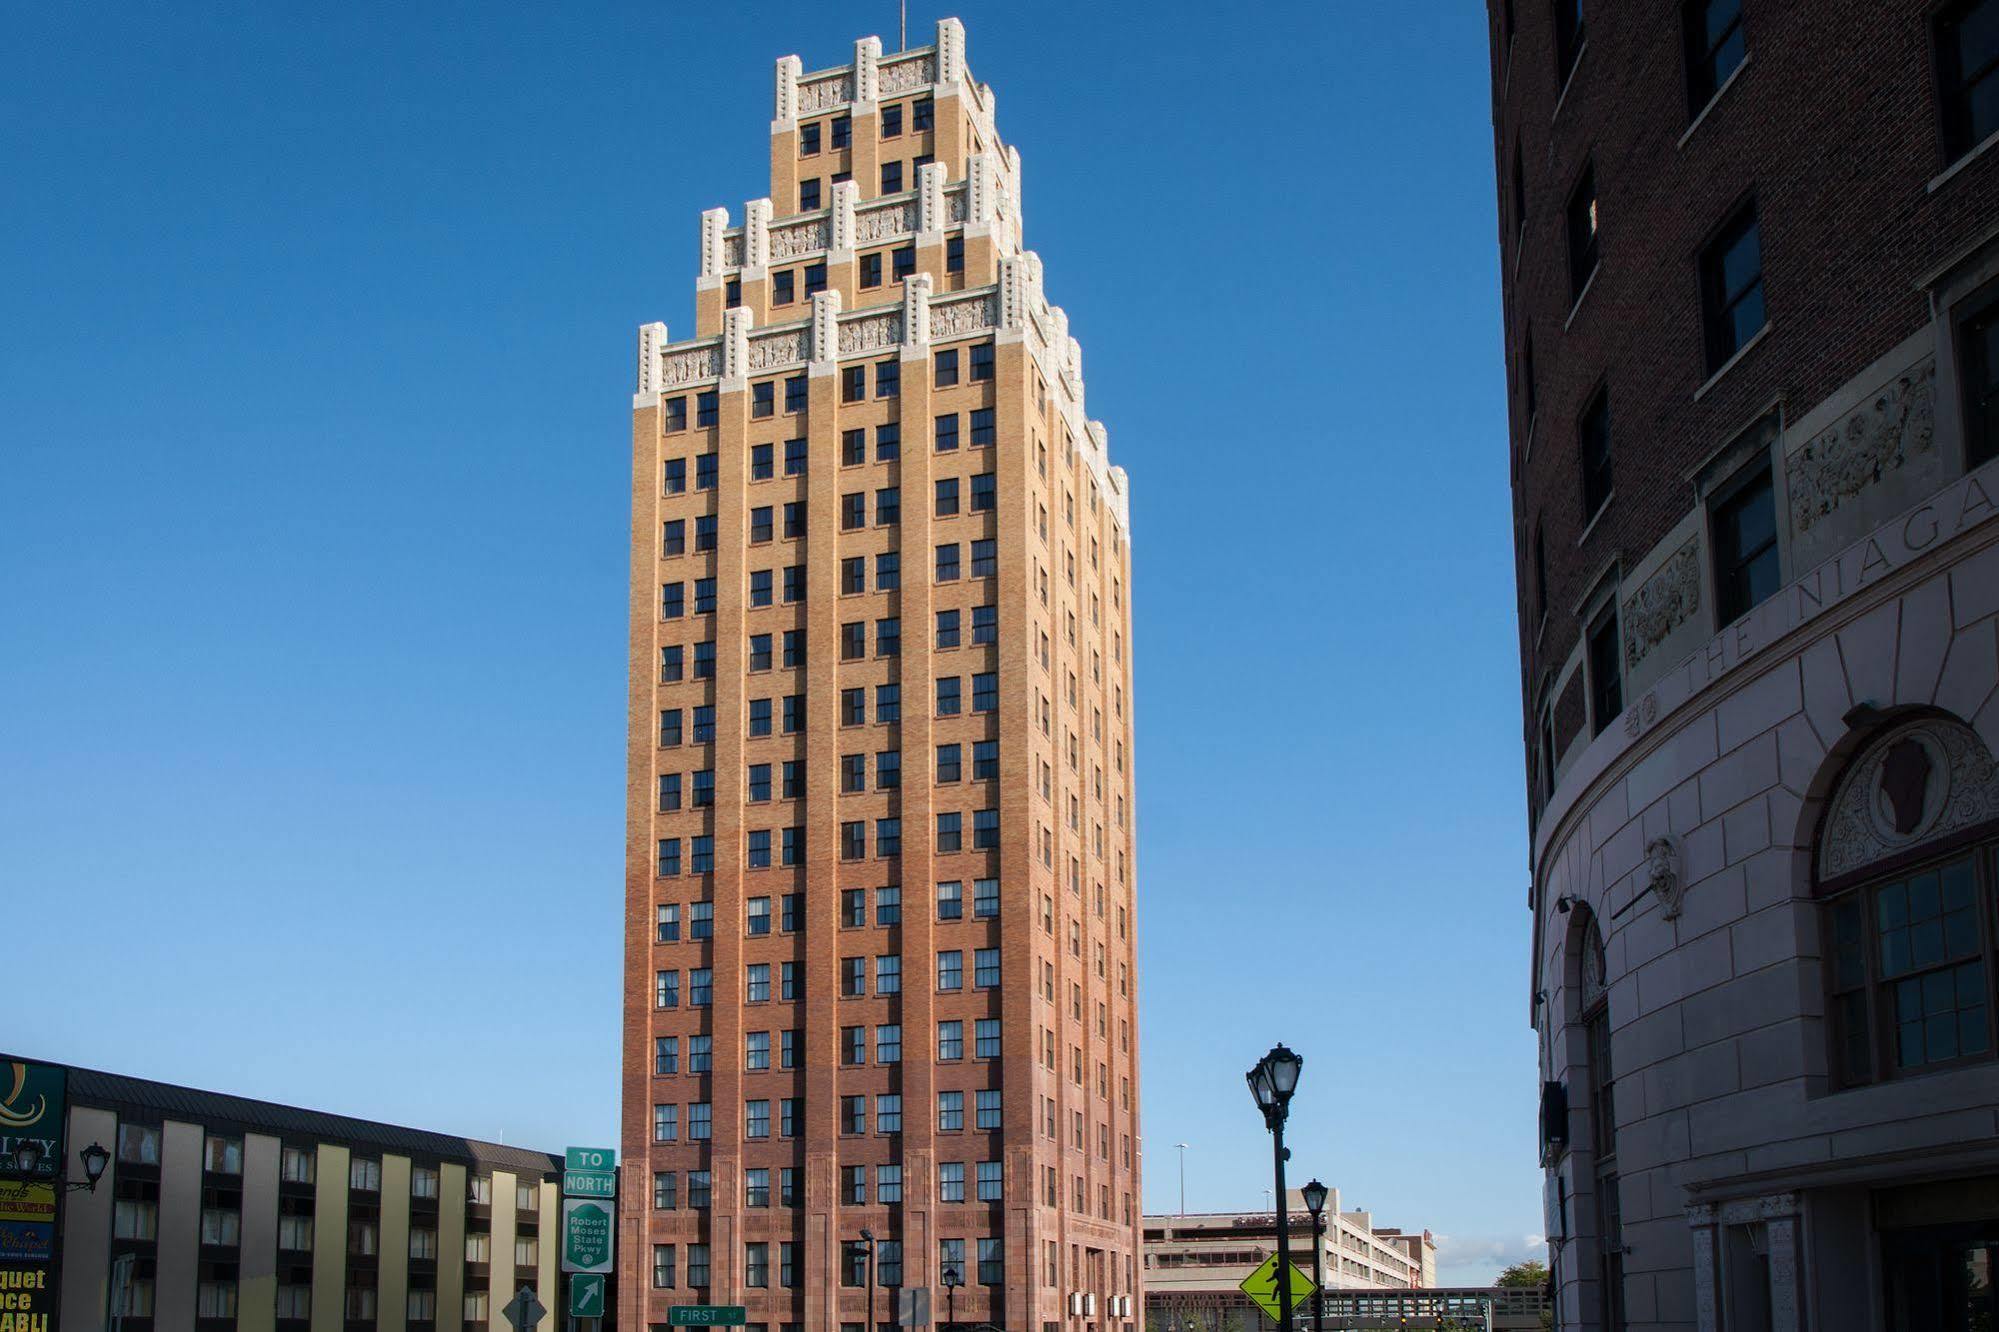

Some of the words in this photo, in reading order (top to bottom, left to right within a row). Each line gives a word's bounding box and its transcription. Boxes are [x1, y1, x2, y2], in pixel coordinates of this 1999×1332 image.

[1683, 618, 1755, 694] THE
[579, 1152, 603, 1166] TO
[566, 1176, 613, 1192] NORTH
[570, 1216, 607, 1227] Robert
[571, 1226, 607, 1235] Moses
[574, 1235, 603, 1244] State
[574, 1244, 602, 1255] Pkwy
[680, 1310, 717, 1321] FIRST
